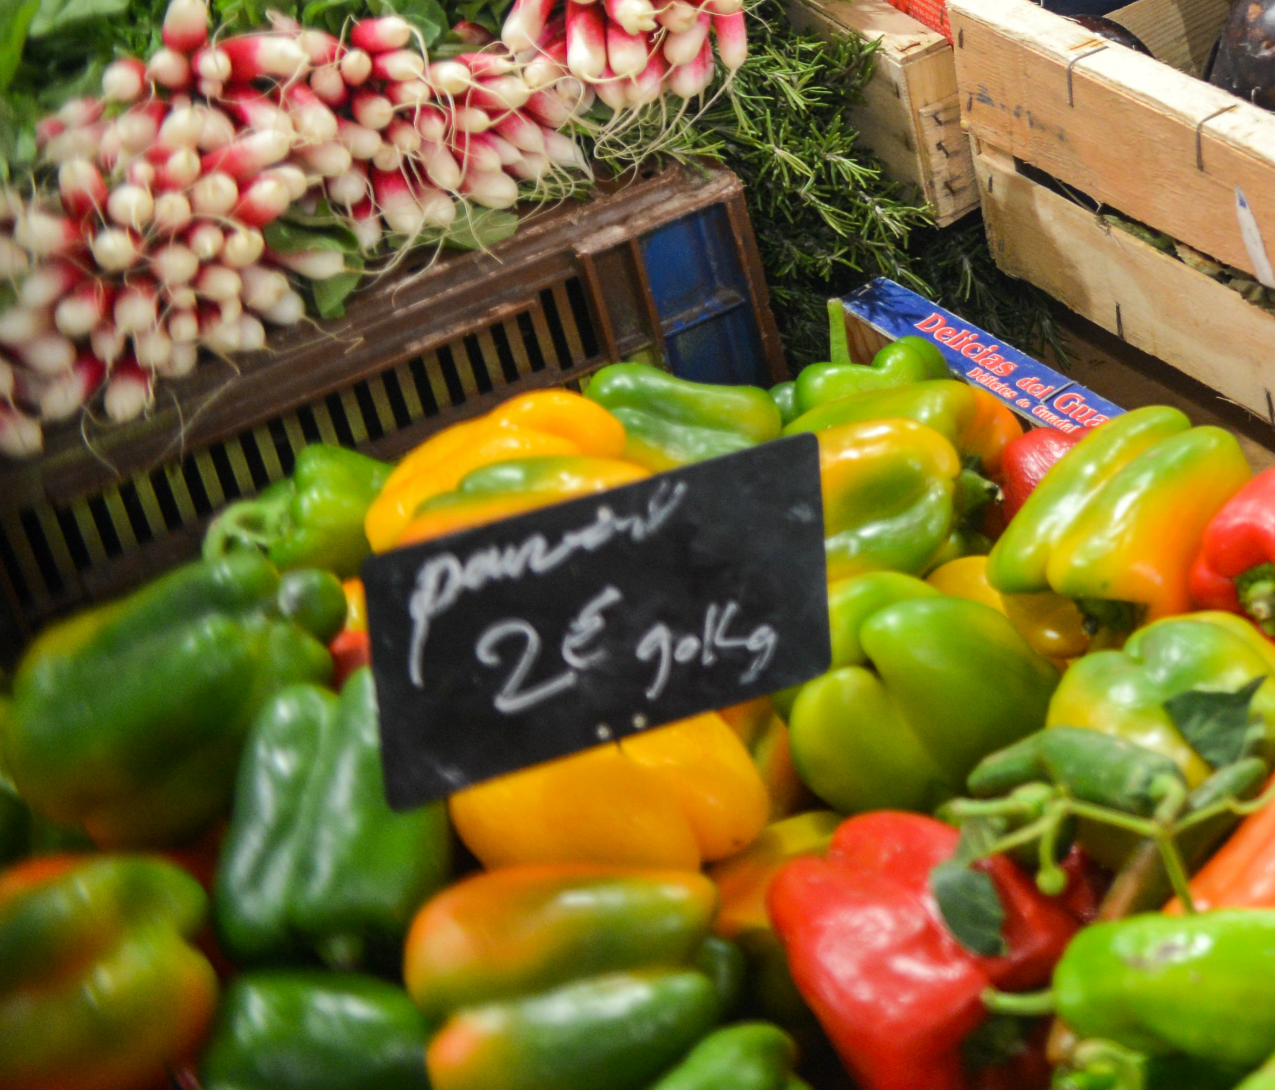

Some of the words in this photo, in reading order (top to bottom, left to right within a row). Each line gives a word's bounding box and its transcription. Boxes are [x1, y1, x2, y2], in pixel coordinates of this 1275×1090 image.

[914, 312, 1018, 377] Delicias
[1016, 376, 1054, 400] del
[1053, 392, 1110, 427] Gua
